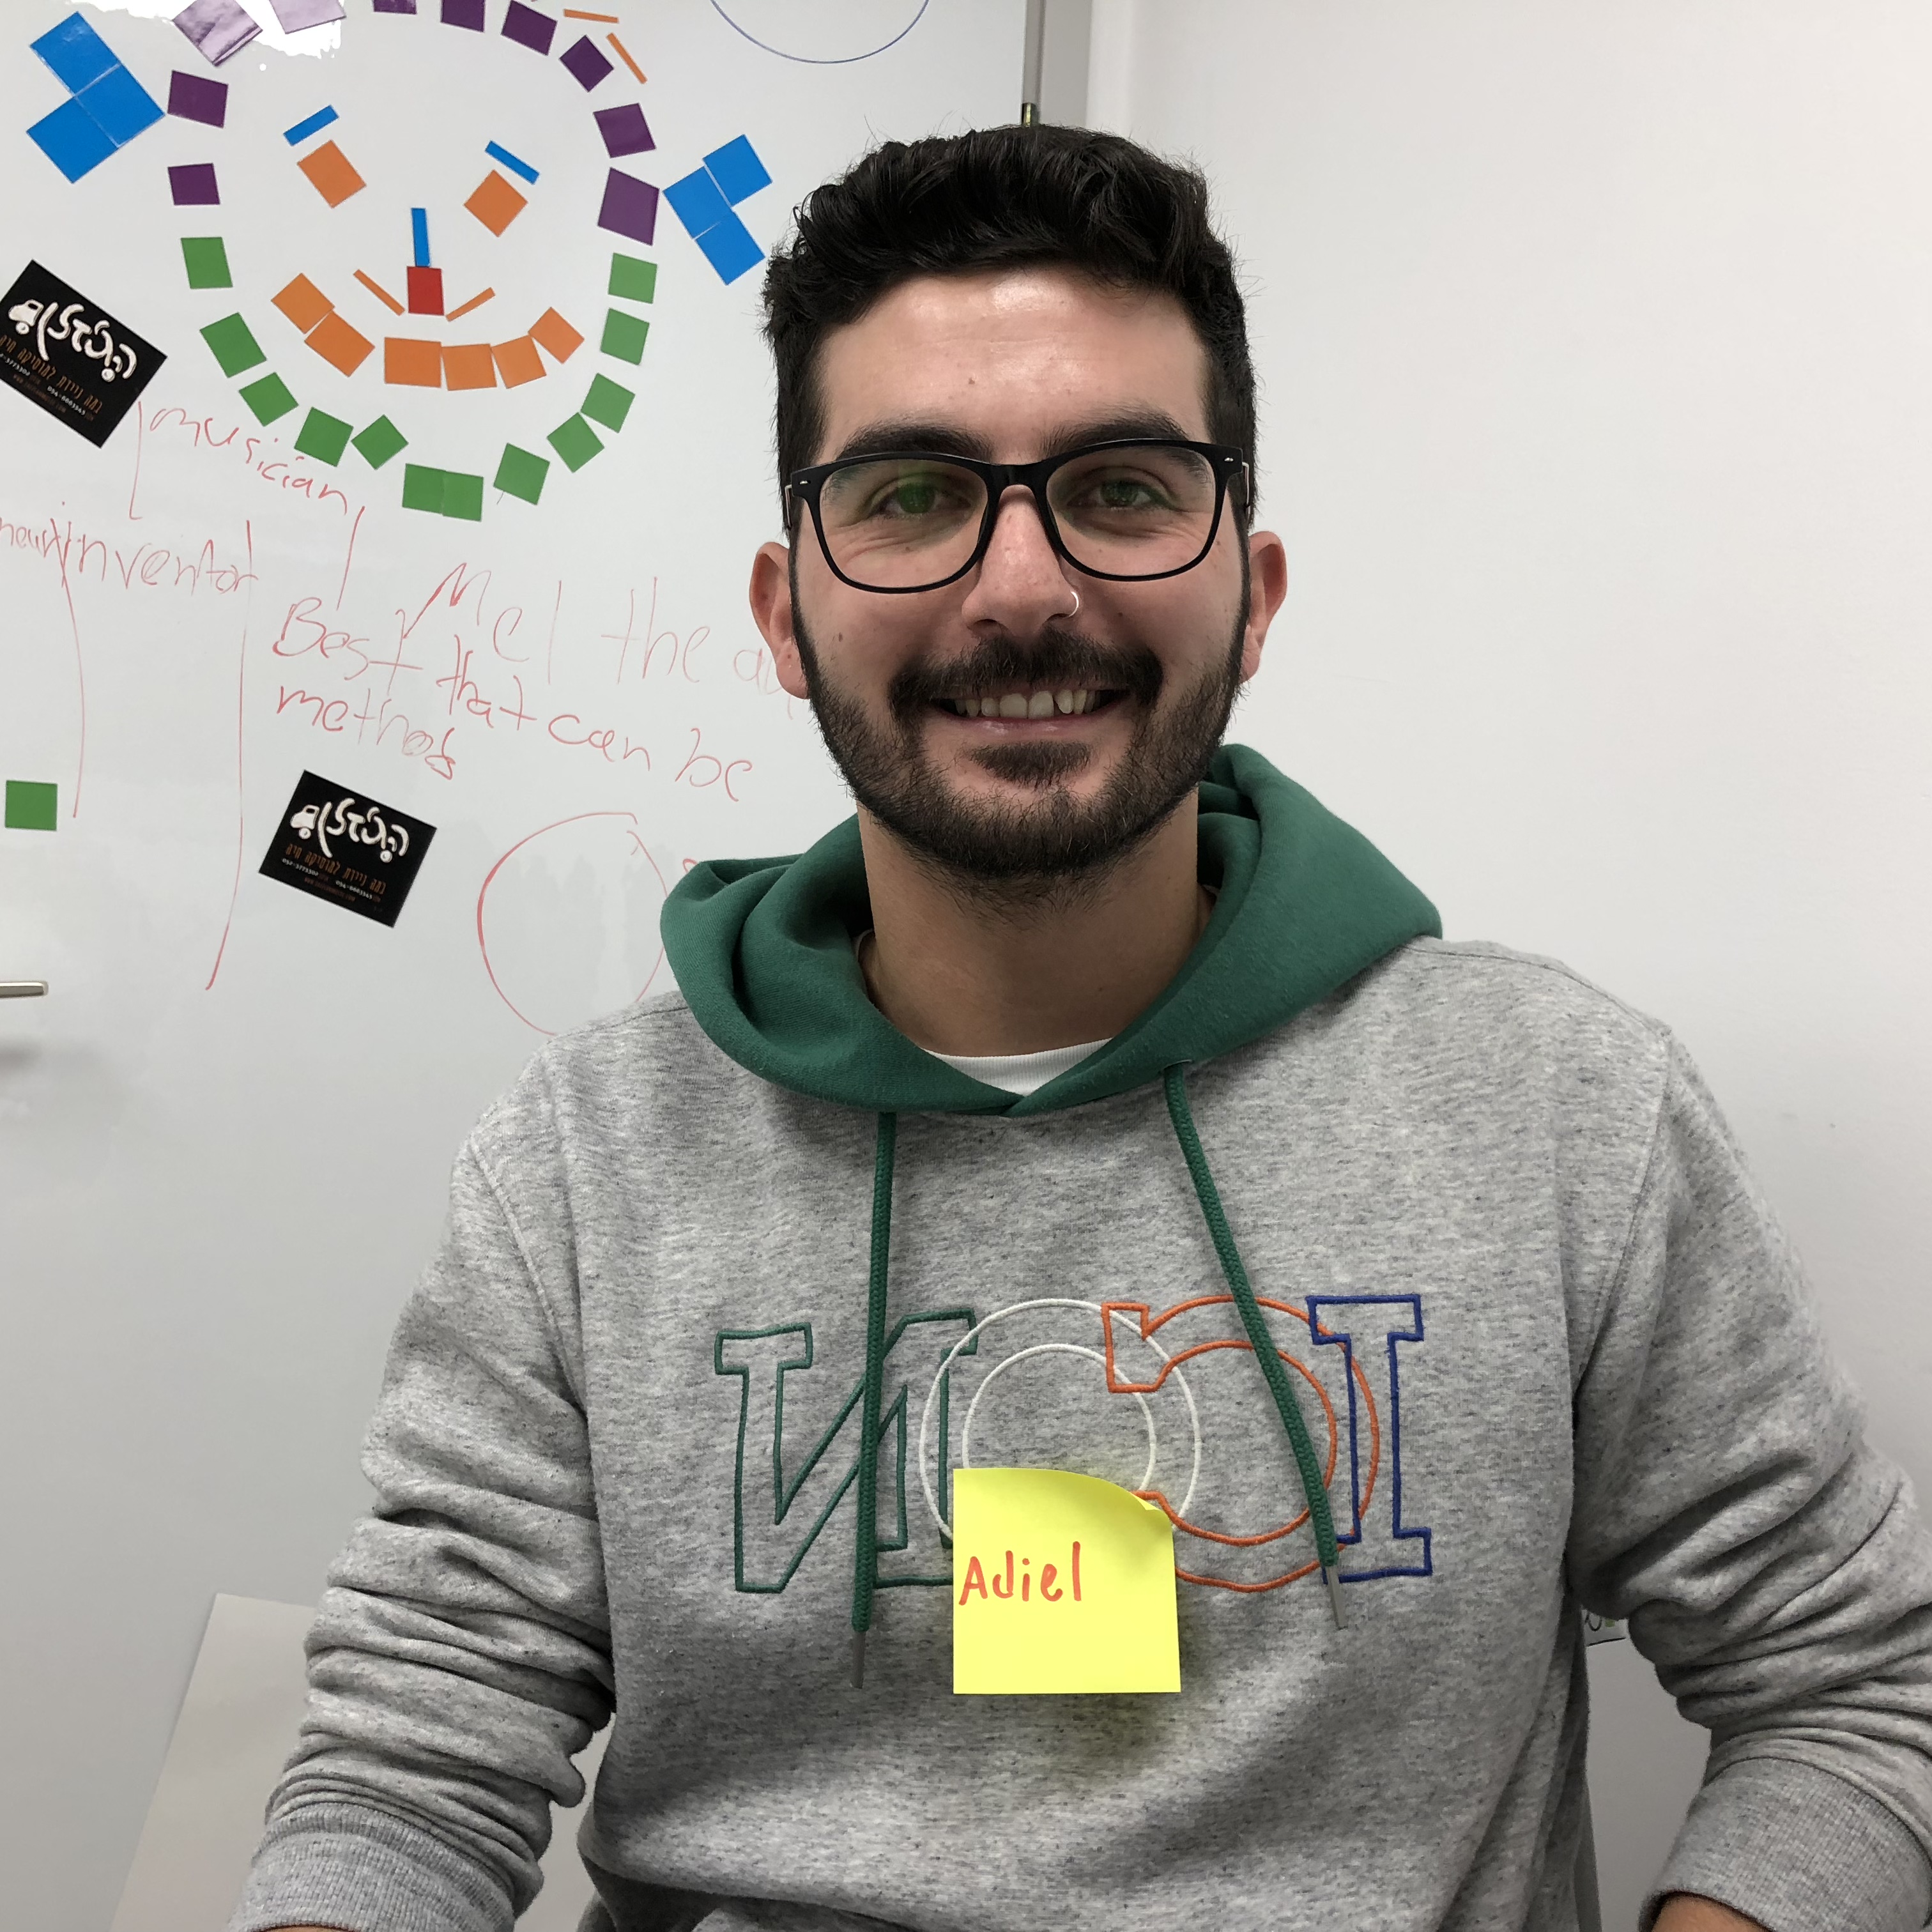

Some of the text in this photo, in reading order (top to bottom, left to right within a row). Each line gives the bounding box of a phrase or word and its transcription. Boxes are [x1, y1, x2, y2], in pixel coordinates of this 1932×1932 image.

[150, 408, 348, 516] musician
[61, 521, 258, 596] inventor
[601, 576, 710, 685] the
[272, 597, 754, 801] Best that can be
[958, 1540, 1082, 1606] Adiel
